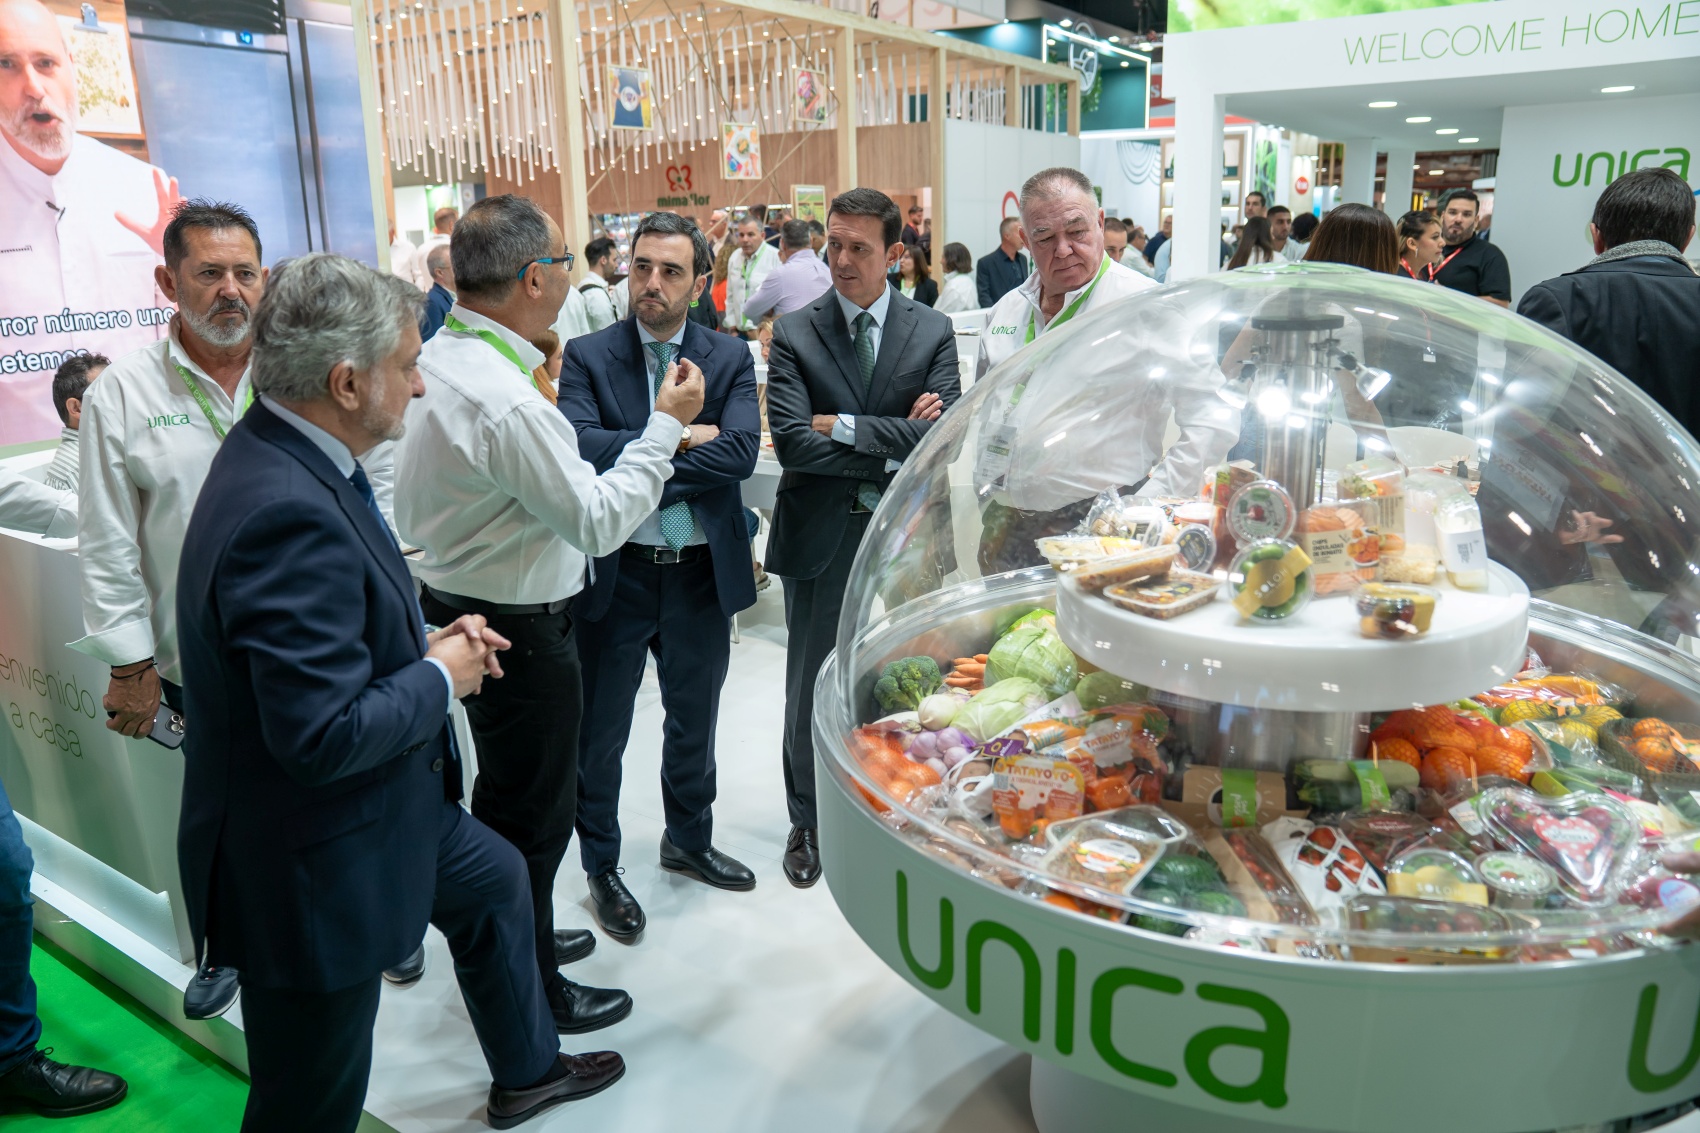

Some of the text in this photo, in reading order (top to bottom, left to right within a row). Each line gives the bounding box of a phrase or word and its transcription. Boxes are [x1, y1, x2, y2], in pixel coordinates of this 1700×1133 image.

[1344, 0, 1700, 65] WELCOME HOME
[0, 316, 38, 336] ror
[44, 308, 132, 333] número
[991, 325, 1018, 335] unica
[0, 349, 89, 374] etem
[147, 413, 190, 429] unica
[10, 702, 83, 760] a casa
[1006, 764, 1069, 782] TATAYOYO
[896, 869, 1291, 1109] unica
